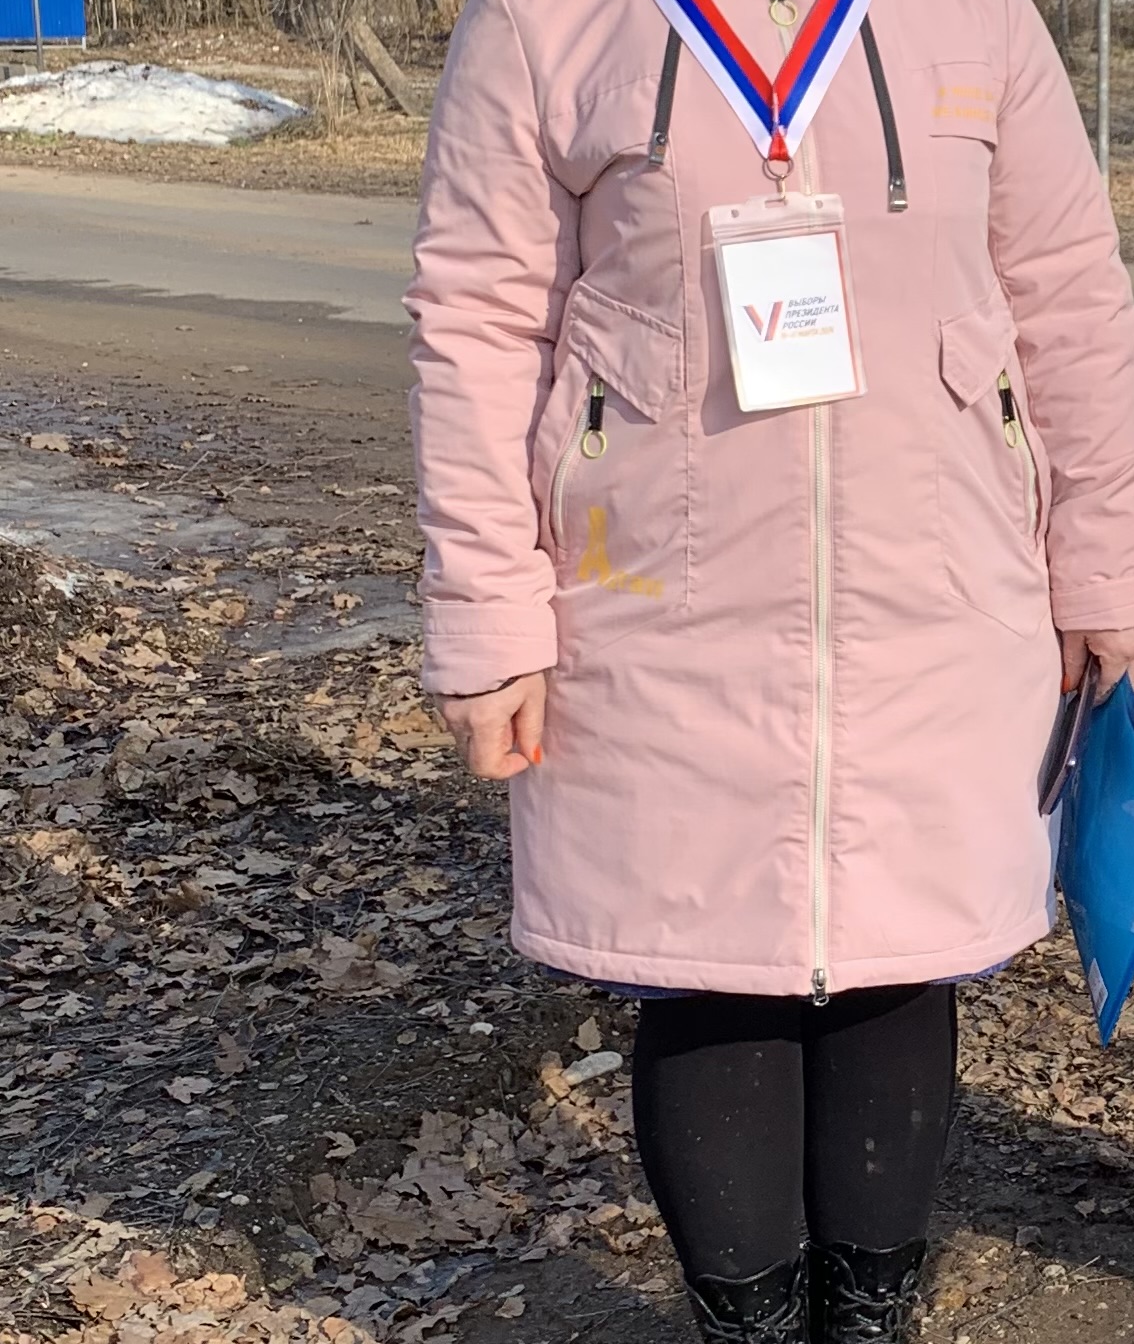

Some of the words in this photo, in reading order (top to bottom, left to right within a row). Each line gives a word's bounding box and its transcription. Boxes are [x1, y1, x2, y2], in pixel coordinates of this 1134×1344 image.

[788, 296, 827, 308] ВЫБОРЫ
[785, 304, 840, 319] ПРЕЗИДЕНТА
[782, 318, 818, 330] РОССИИ
